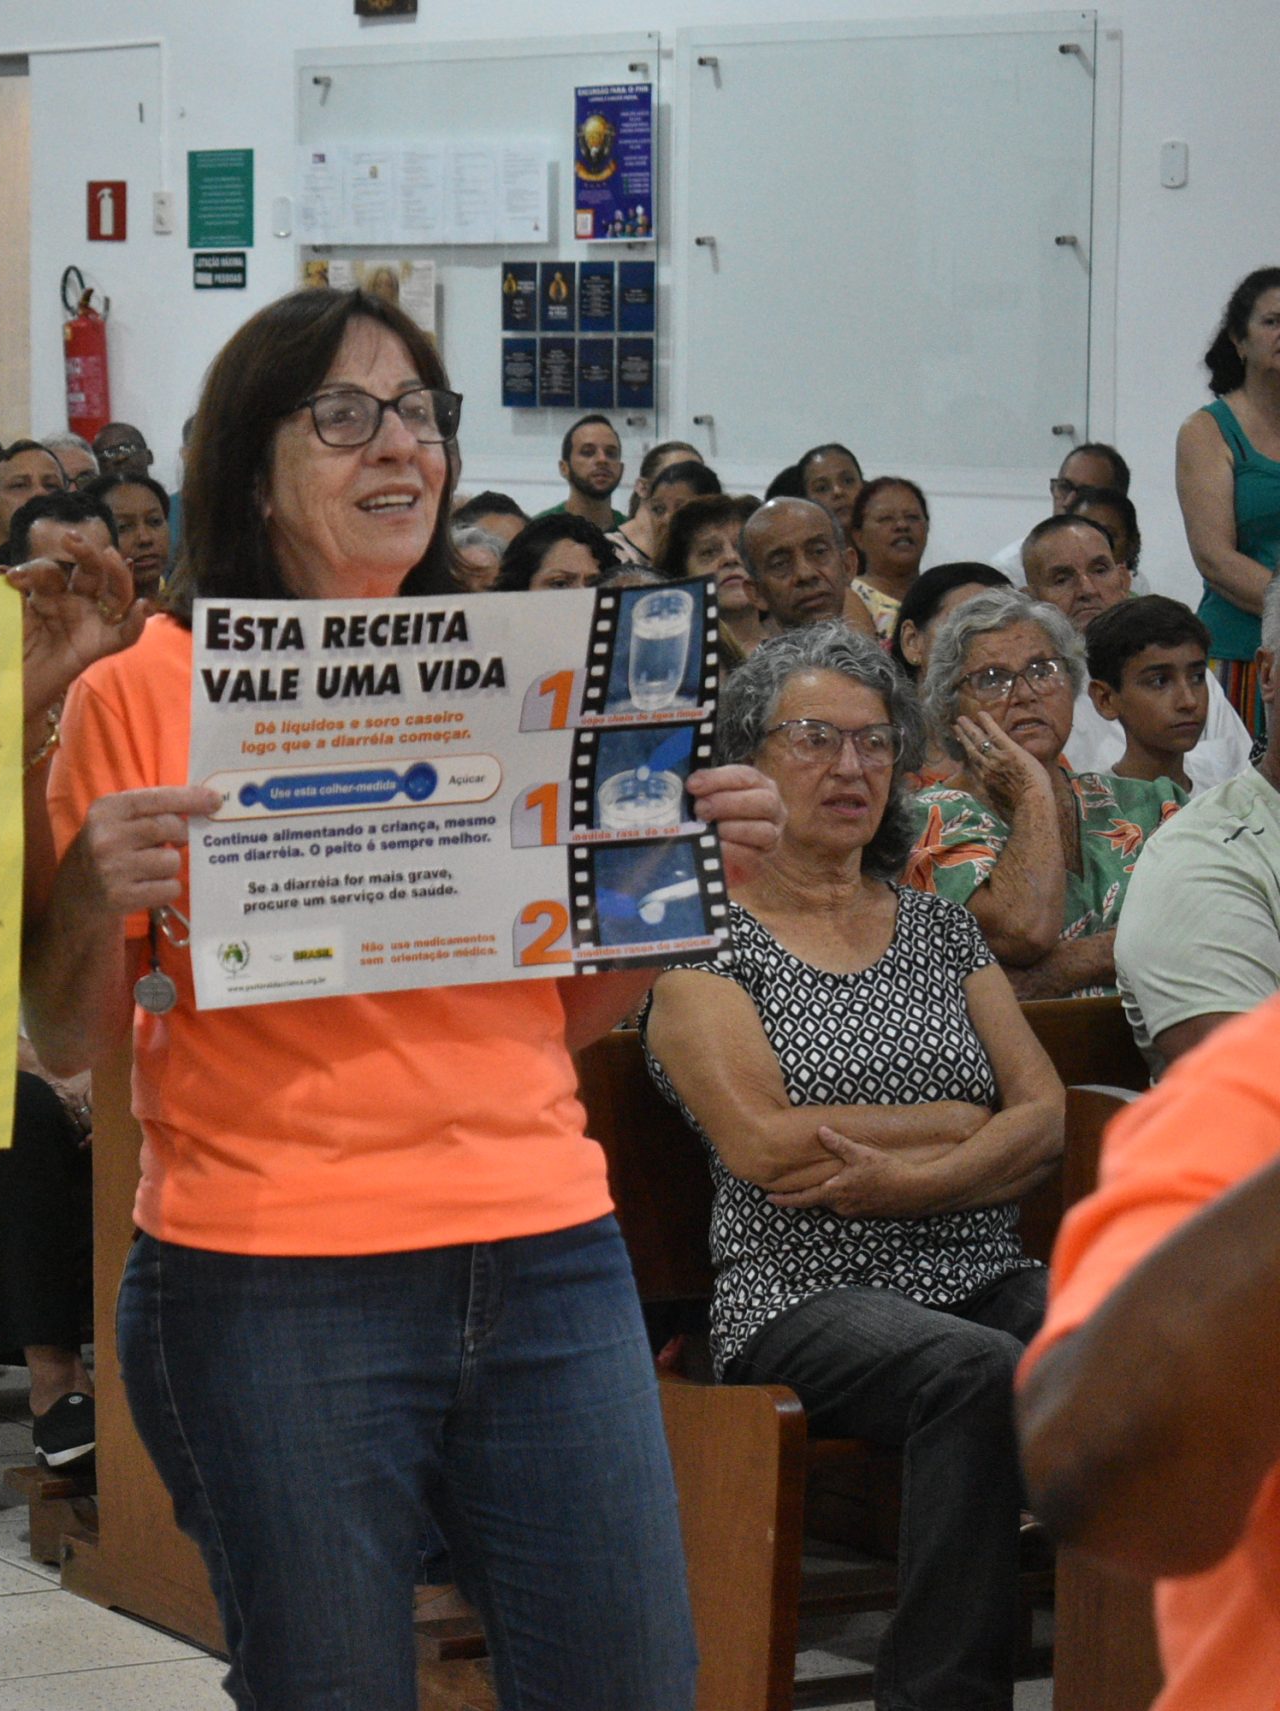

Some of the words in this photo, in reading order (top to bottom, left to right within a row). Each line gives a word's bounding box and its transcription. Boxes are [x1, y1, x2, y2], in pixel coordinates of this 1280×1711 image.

[206, 608, 304, 650] ESTA
[322, 611, 468, 648] RECEITA
[202, 668, 300, 702] VALE
[317, 663, 400, 698] UMA
[418, 657, 506, 692] VIDA
[539, 670, 575, 729] 1
[255, 720, 275, 734] Dê
[282, 716, 344, 735] líquidos
[351, 719, 359, 729] e
[366, 716, 399, 728] soro
[405, 710, 463, 726] caseiro
[241, 738, 275, 755] logo
[282, 740, 310, 753] que
[317, 739, 325, 749] a
[332, 731, 393, 748] diarréia
[400, 731, 469, 746] começar.
[270, 784, 290, 798] Use
[294, 782, 316, 796] esta
[319, 778, 395, 795] colher-medida
[449, 771, 484, 787] Açúcar
[526, 783, 559, 846] 1
[203, 829, 267, 846] Continue
[273, 822, 362, 841] alimentando
[368, 824, 376, 834] a
[381, 817, 442, 836] criança,
[444, 816, 495, 829] mesmo
[210, 852, 238, 863] com
[244, 844, 304, 861] diarréia.
[310, 842, 319, 856] O
[325, 839, 361, 858] peito
[367, 838, 374, 852] é
[381, 838, 432, 853] sempre
[438, 830, 490, 847] melhor.
[248, 879, 265, 893] Se
[272, 882, 278, 892] a
[284, 874, 339, 891] diarréia
[344, 872, 362, 887] for
[369, 870, 402, 885] mais
[408, 870, 452, 885] grave,
[244, 898, 297, 914] procure
[303, 896, 324, 907] um
[330, 888, 383, 907] serviço
[389, 887, 405, 901] de
[411, 884, 458, 898] saúde.
[361, 942, 384, 952] Não
[414, 934, 496, 948] medicamentos
[521, 900, 572, 964] 2
[361, 957, 384, 965] sem
[391, 950, 449, 963] orientação
[453, 947, 497, 958] médica.
